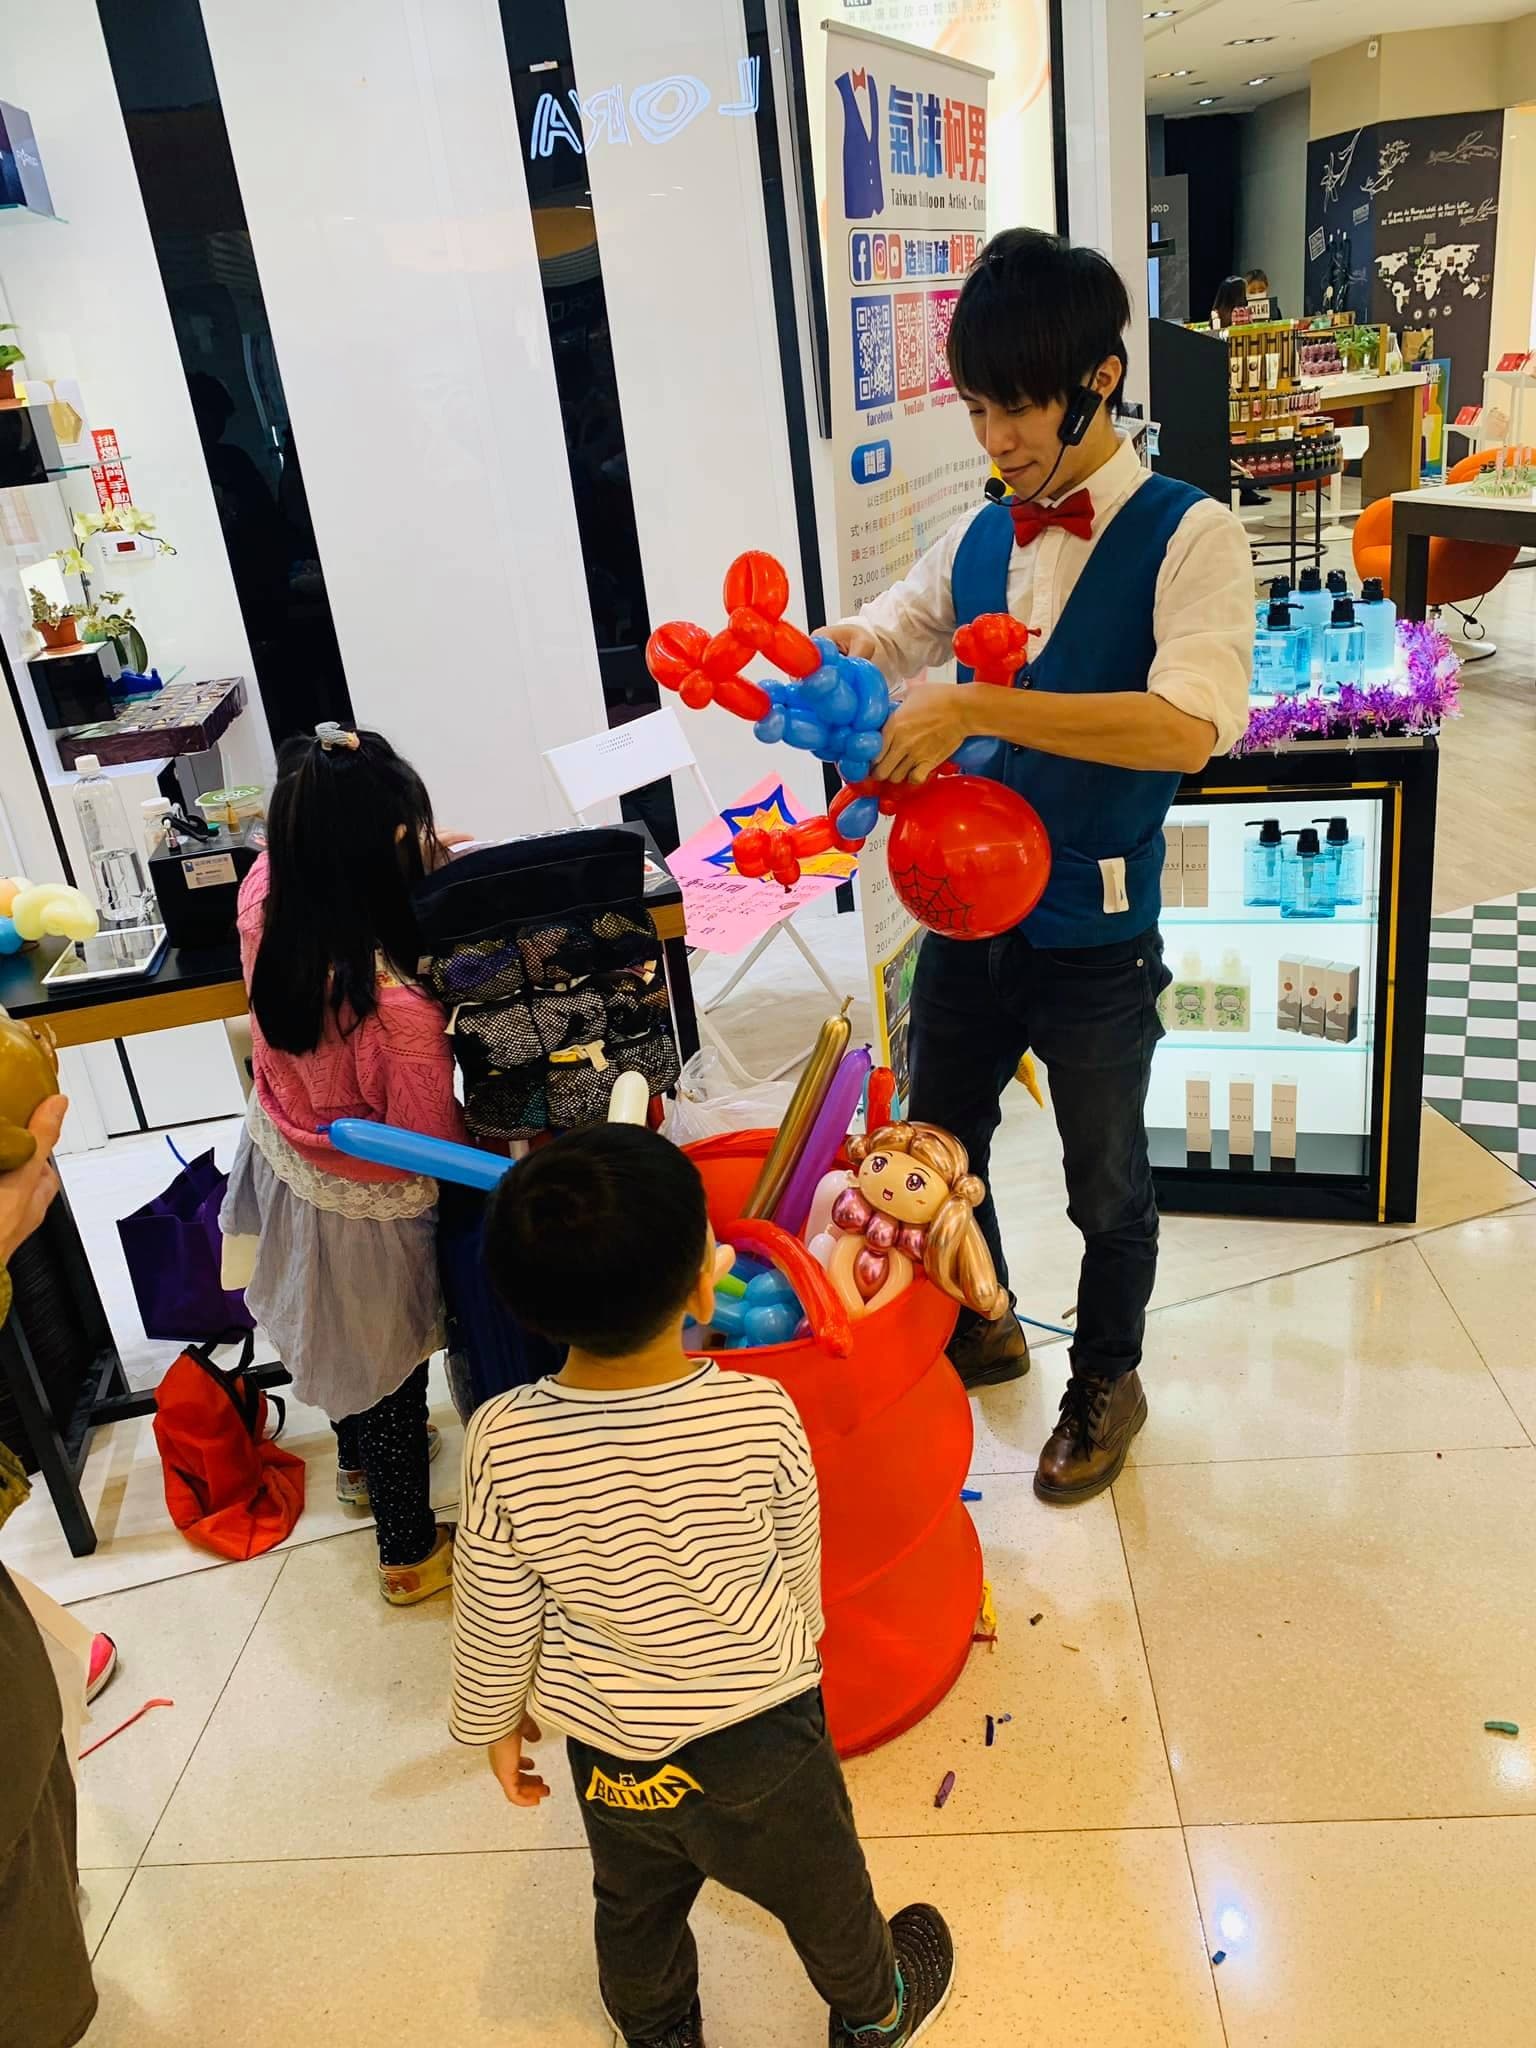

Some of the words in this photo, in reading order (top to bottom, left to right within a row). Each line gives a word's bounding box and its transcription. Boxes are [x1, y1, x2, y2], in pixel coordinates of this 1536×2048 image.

[891, 188, 917, 207] Taiwan
[949, 192, 967, 210] Artist
[595, 1775, 692, 1806] BATMAN
